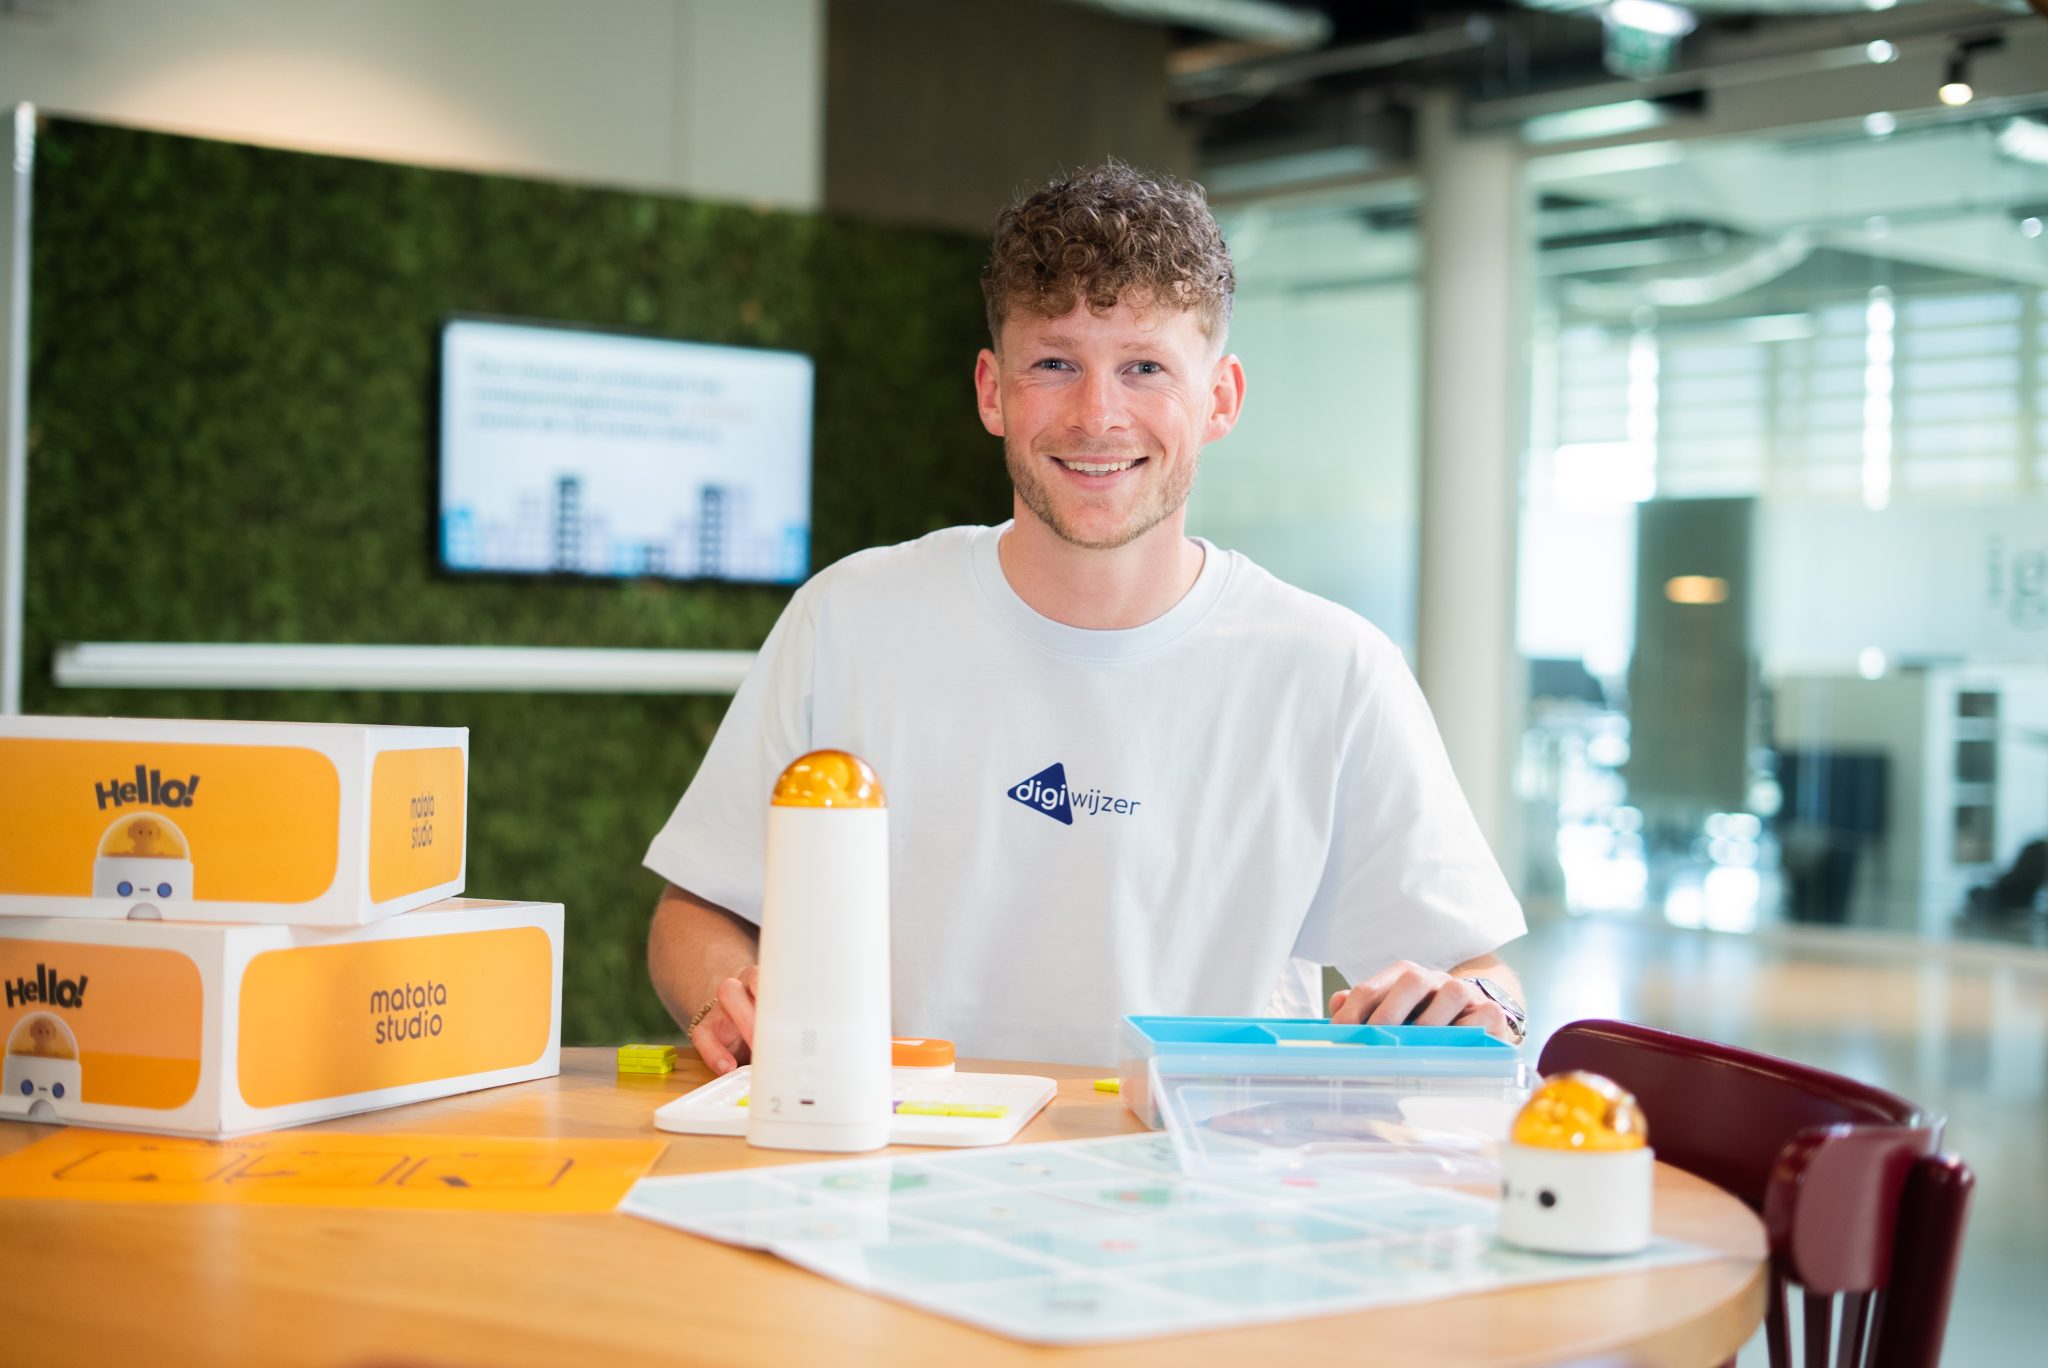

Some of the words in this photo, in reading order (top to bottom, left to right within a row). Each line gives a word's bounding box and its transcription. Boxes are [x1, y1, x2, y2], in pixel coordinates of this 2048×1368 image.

[95, 764, 200, 810] Hello!
[410, 792, 434, 819] matata
[411, 819, 432, 849] studio
[5, 963, 88, 1008] Hello!
[370, 979, 446, 1014] matata
[375, 1009, 442, 1044] studio
